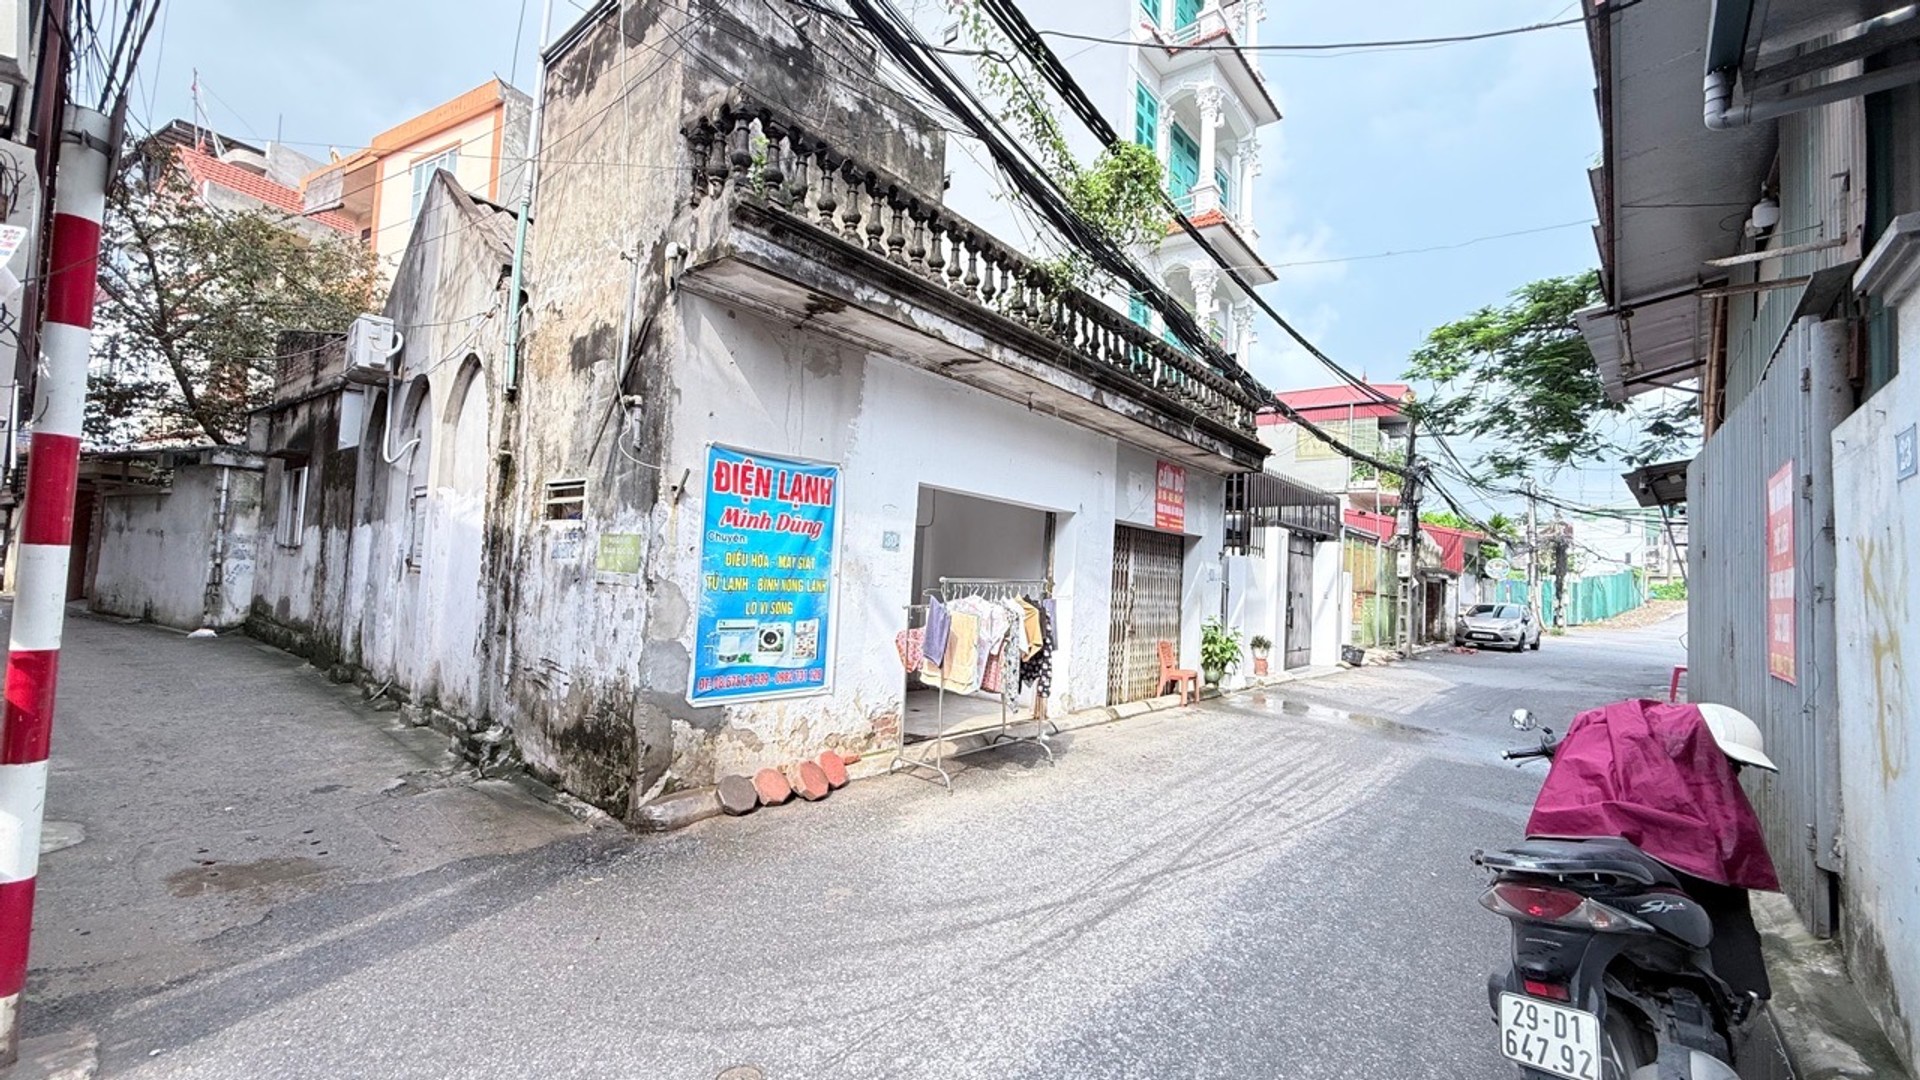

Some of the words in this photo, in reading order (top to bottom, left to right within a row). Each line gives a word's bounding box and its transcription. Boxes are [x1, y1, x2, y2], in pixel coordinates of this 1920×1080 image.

[714, 459, 772, 502] ĐIỆN
[777, 470, 834, 508] LẠNH
[720, 508, 772, 531] Minh
[1513, 1000, 1580, 1044] 29-D1
[1506, 1029, 1594, 1080] 647.92
